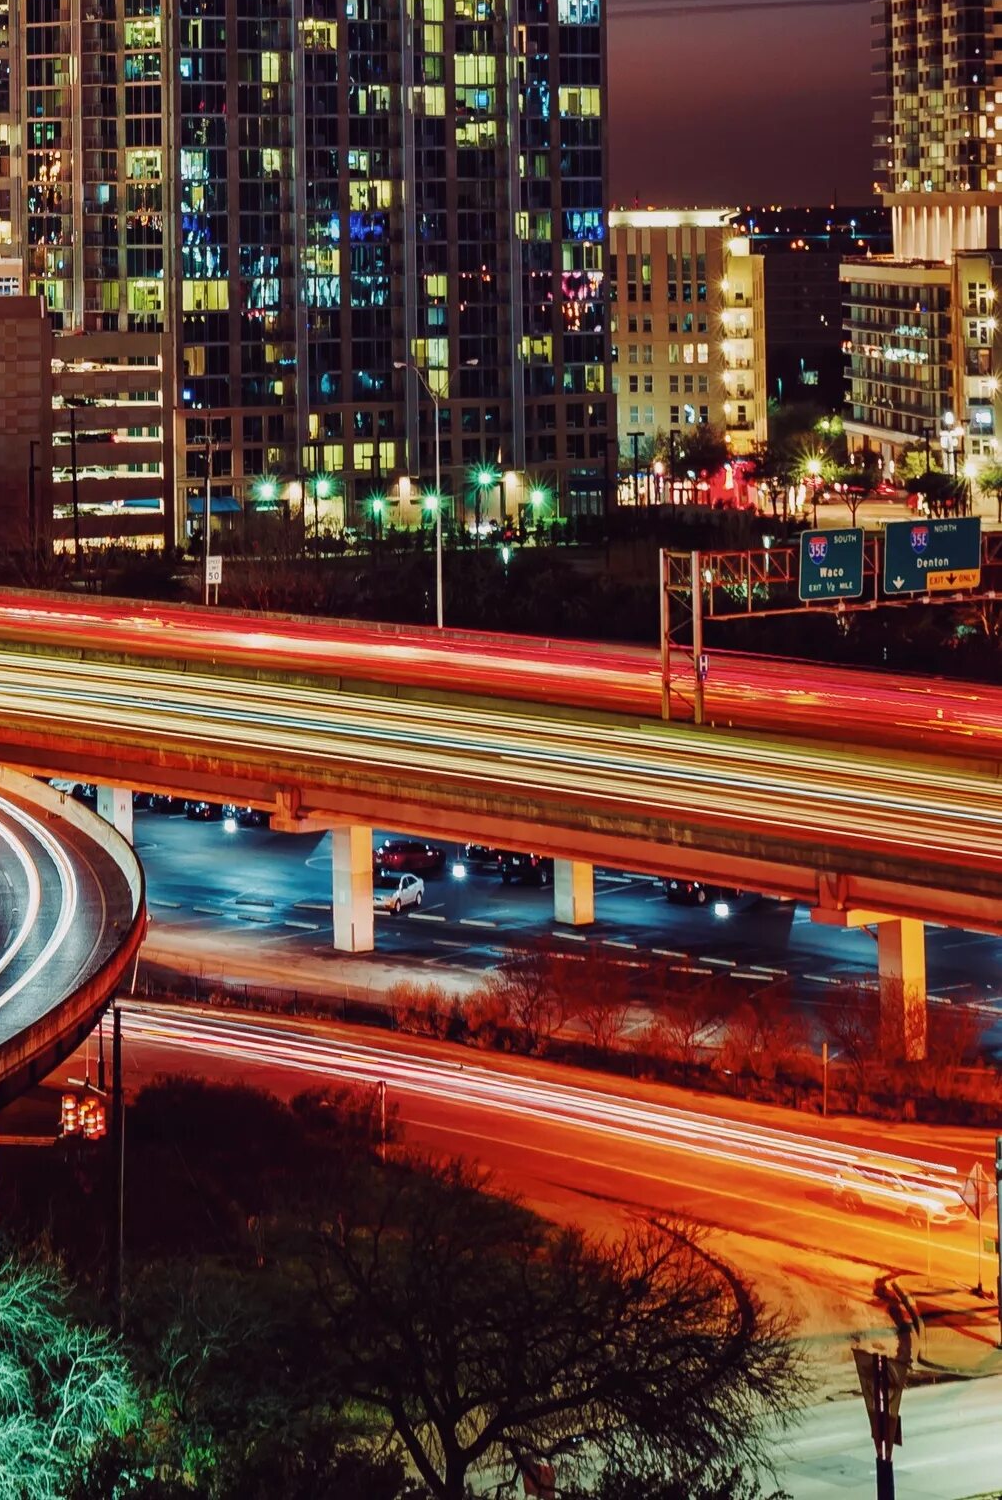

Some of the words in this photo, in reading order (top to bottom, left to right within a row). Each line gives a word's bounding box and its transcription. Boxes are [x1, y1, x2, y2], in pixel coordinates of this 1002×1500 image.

[911, 533, 927, 546] 35E
[934, 524, 957, 533] NORTH
[810, 544, 826, 557] 35E
[833, 534, 857, 544] SOUTH
[917, 557, 949, 568] Denton
[208, 572, 219, 580] 50
[819, 567, 844, 578] Waco
[930, 576, 944, 585] EXIT
[958, 574, 976, 583] ONLY
[808, 584, 822, 592] EXIT
